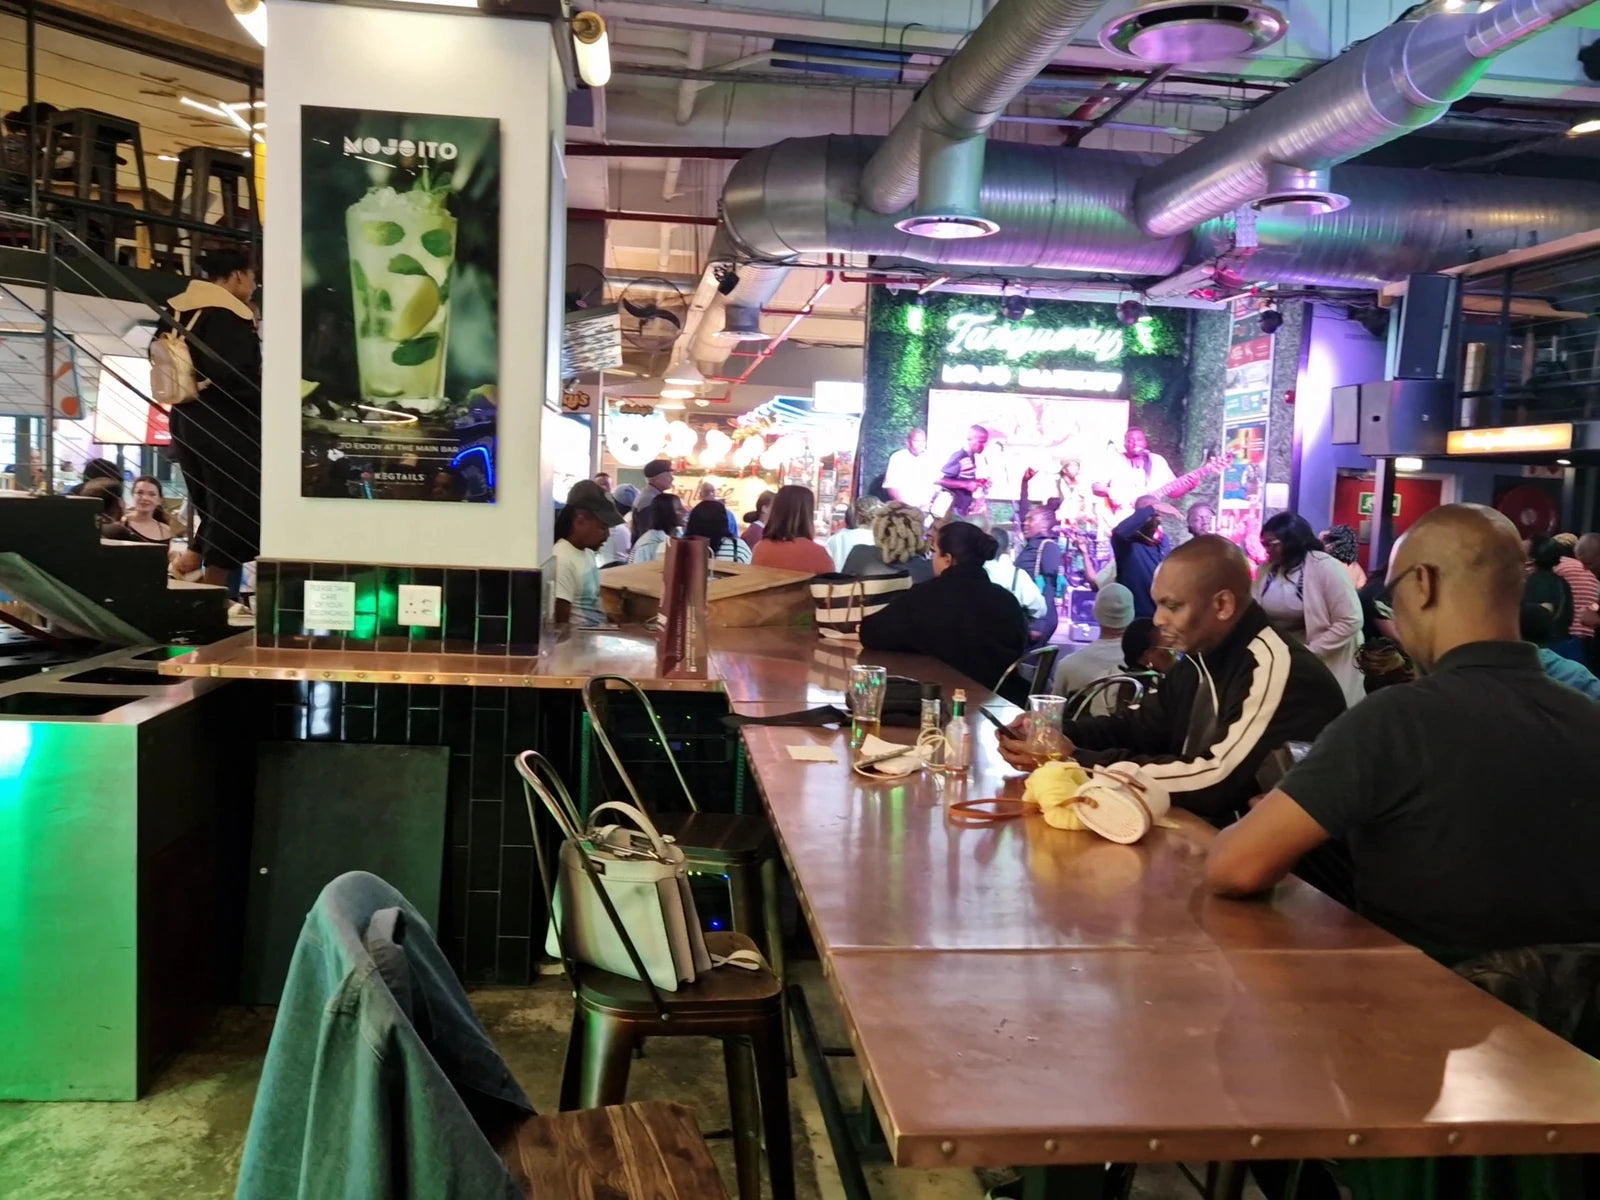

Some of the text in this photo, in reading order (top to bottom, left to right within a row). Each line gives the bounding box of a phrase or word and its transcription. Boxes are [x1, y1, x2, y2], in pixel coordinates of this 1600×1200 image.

[343, 136, 458, 160] MOJOITO
[354, 442, 382, 450] ENJOY
[374, 472, 425, 481] KEGTAILS
